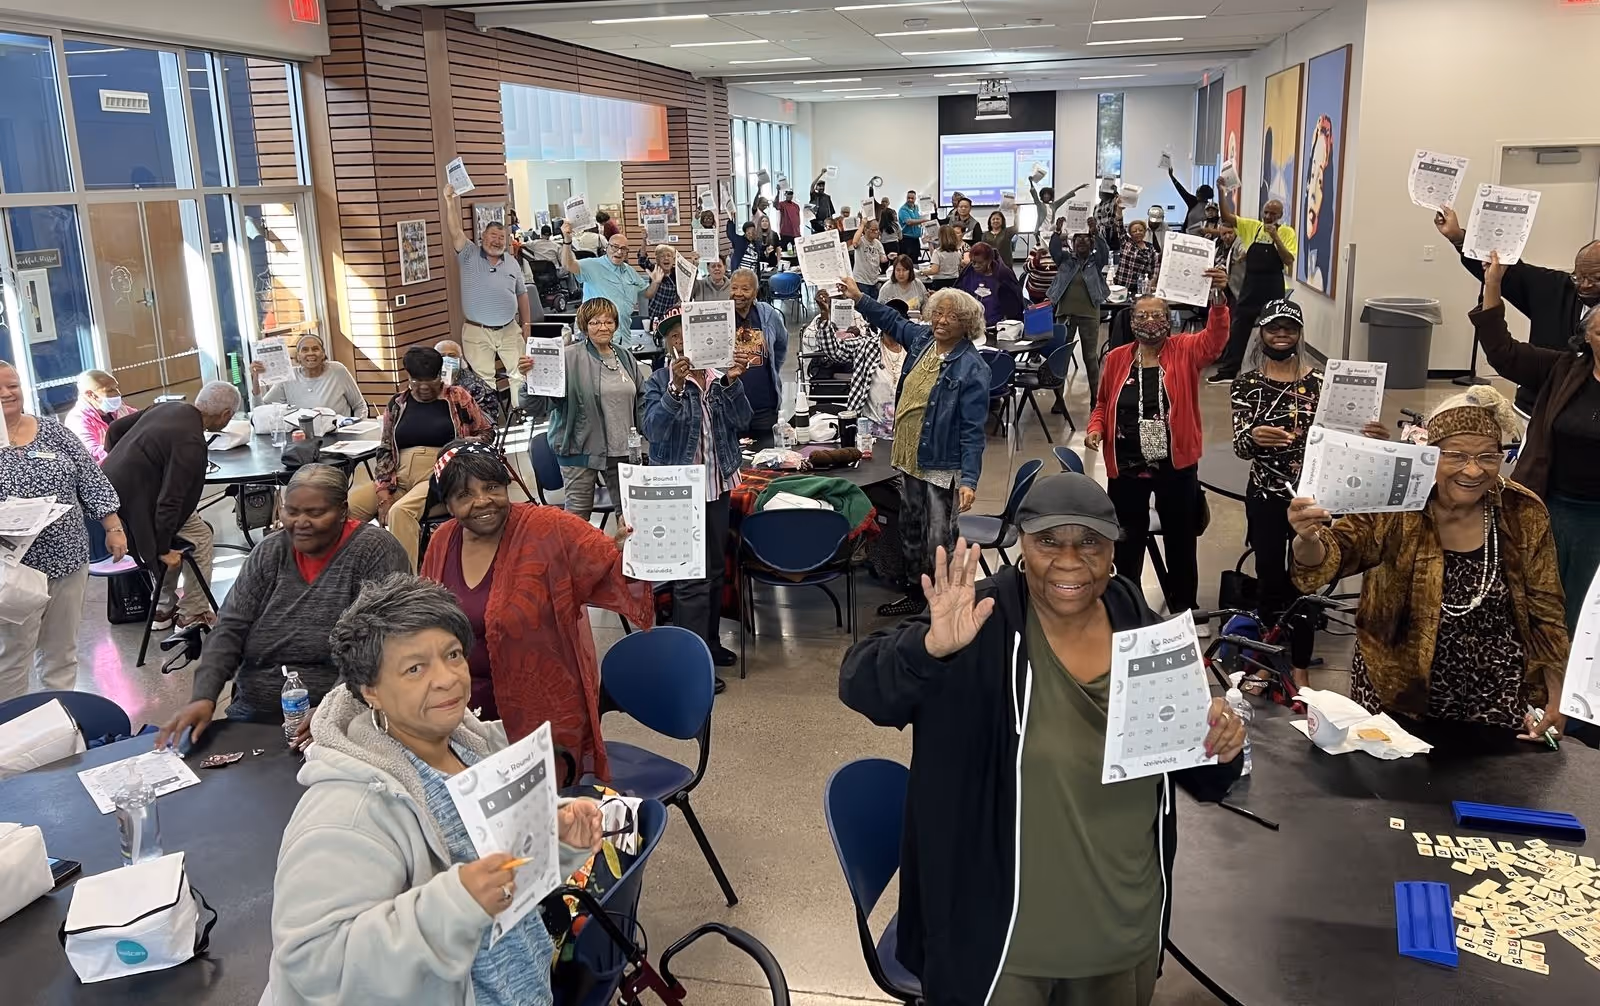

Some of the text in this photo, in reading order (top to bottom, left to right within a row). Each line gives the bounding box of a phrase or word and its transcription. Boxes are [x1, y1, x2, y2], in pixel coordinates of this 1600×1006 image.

[1275, 304, 1301, 317] Vegas
[652, 475, 674, 483] Round
[1392, 461, 1408, 504] BINGO
[631, 488, 689, 497] BINGO
[1162, 632, 1182, 646] Round
[1132, 648, 1197, 671] BINGO
[510, 754, 531, 772] Round
[487, 766, 545, 811] BINGO
